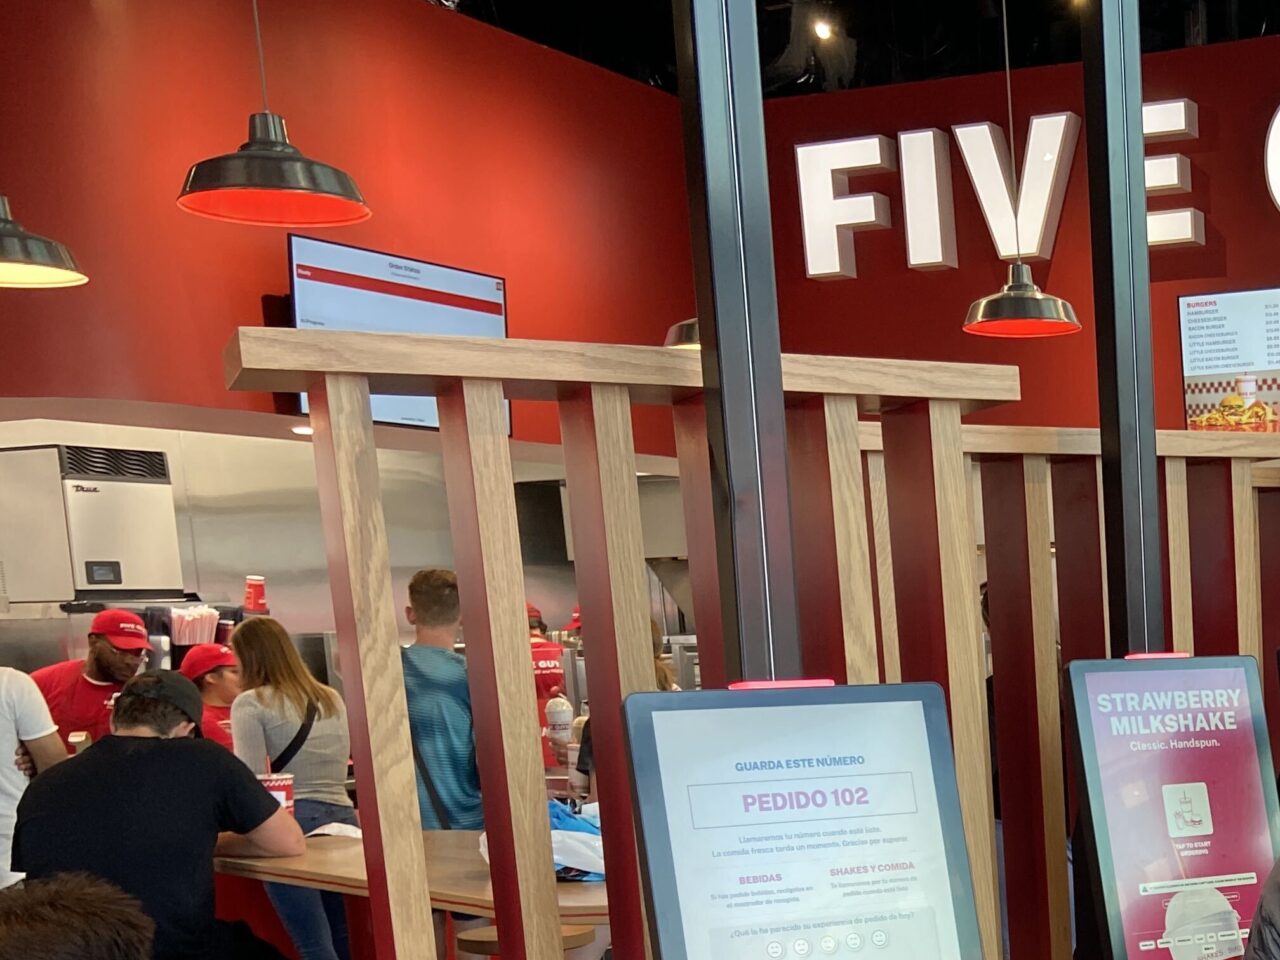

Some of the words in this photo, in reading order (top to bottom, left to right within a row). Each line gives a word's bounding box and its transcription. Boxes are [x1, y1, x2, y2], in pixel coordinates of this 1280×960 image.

[794, 98, 1204, 280] FIVE
[538, 660, 560, 668] GUY
[1097, 688, 1241, 713] STRAWBERRY
[1110, 711, 1237, 736] MILKSHAKE
[1129, 740, 1169, 752] Classic.
[1170, 738, 1220, 750] Handspun.
[735, 760, 784, 772] GUARDA
[786, 758, 815, 769] ESTE
[816, 755, 865, 768] NÚMERO
[742, 789, 827, 813] PEDIDO
[831, 787, 869, 807] 102
[738, 833, 784, 845] Llamaremos
[785, 833, 793, 841] tu
[794, 830, 822, 840] número
[822, 828, 848, 838] cuando
[712, 849, 722, 858] La
[722, 847, 750, 858] comida
[751, 845, 774, 856] fresca
[775, 843, 795, 853] tarda
[842, 838, 868, 848] Gracias
[869, 838, 881, 847] por
[830, 865, 869, 877] SHAKES
[870, 864, 877, 872] Y
[877, 861, 915, 872] COMIDA
[739, 873, 783, 885] BEBIDAS
[770, 923, 801, 935] parecido
[854, 917, 863, 925] de
[864, 914, 887, 924] pedido
[888, 912, 897, 921] de
